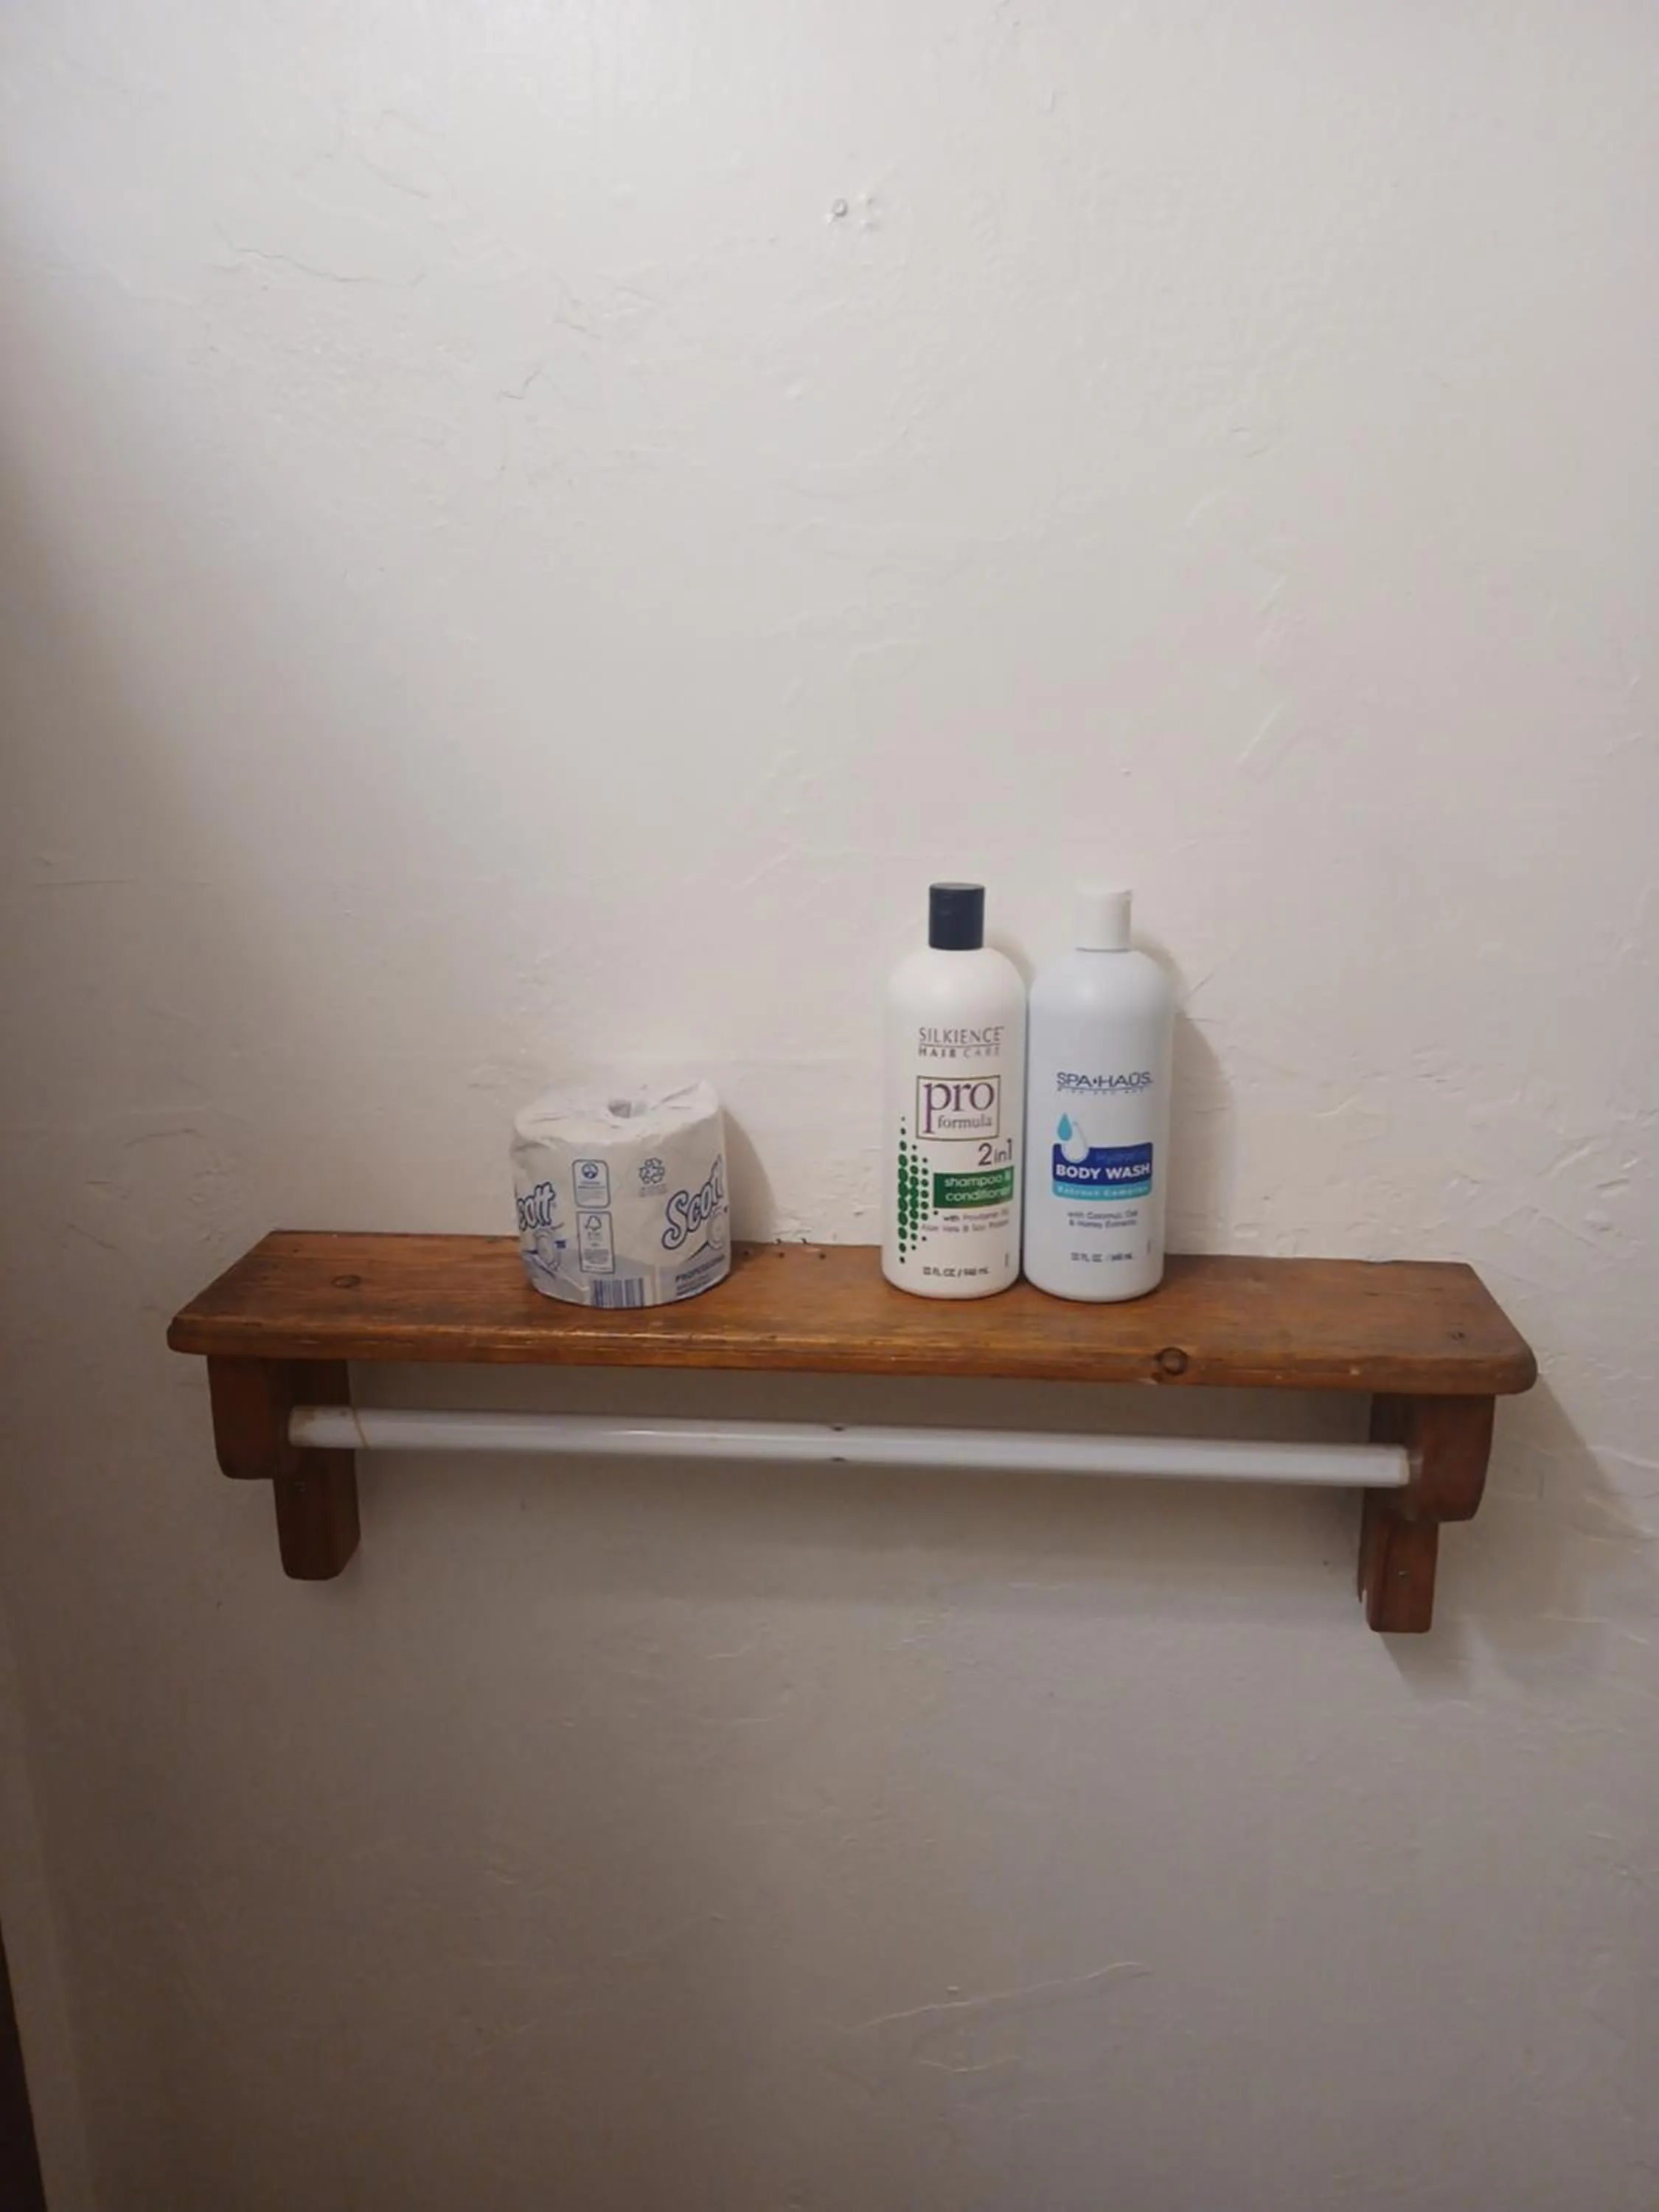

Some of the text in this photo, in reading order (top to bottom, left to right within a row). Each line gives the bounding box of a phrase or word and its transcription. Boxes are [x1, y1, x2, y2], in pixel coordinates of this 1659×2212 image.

[918, 1026, 1004, 1045] SILKIENCE
[918, 1046, 1001, 1058] HAIR CARE
[922, 1082, 995, 1135] pro
[937, 1113, 992, 1130] formula
[1055, 1162, 1150, 1180] BODY WASH
[944, 1174, 1002, 1189] shampoo
